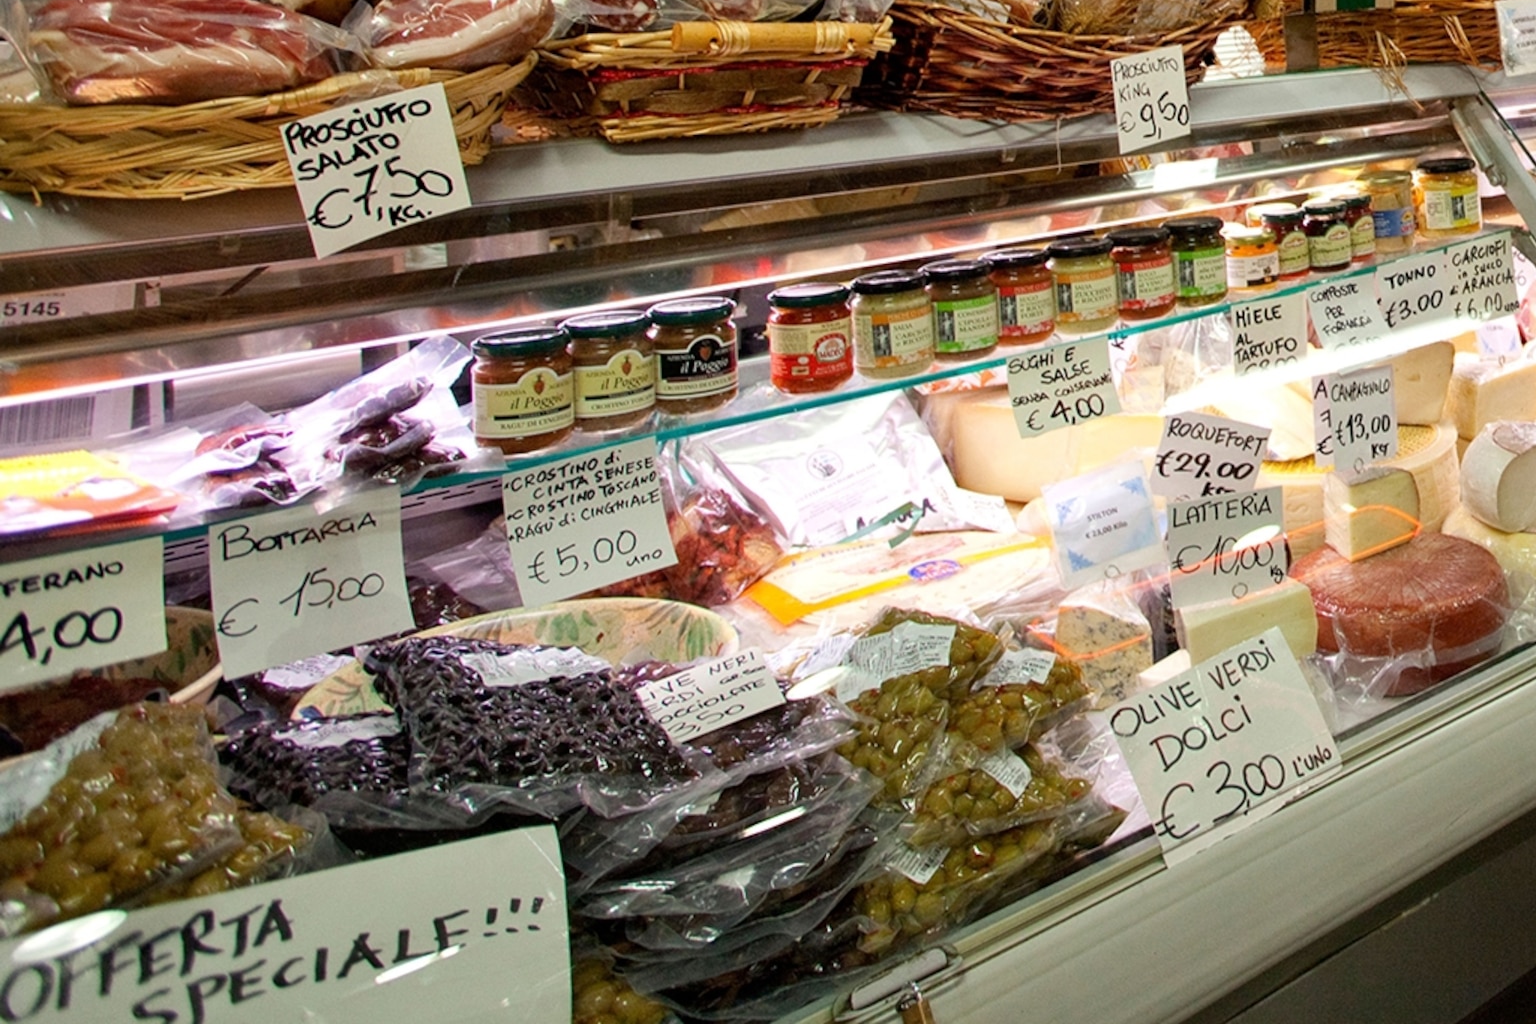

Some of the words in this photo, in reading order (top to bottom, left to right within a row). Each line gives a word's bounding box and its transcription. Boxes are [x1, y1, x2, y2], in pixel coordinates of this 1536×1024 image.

[1113, 57, 1179, 82] PROSCIUTTO
[1118, 82, 1151, 103] KING
[285, 100, 432, 155] PROSCIUTTO
[1120, 111, 1136, 133] €
[1140, 91, 1190, 139] 9,50
[297, 133, 400, 181] SALATO
[308, 188, 352, 228] €
[1384, 264, 1436, 291] TONNO
[1462, 272, 1514, 296] ARANCIA
[3, 301, 60, 317] 5145
[1235, 304, 1282, 327] MIELE
[1234, 337, 1297, 364] TARTUFO
[1235, 332, 1252, 347] AL
[680, 361, 690, 374] il
[691, 358, 729, 373] Poggio
[1008, 349, 1054, 375] SUGHI
[1064, 346, 1076, 362] E
[1041, 360, 1093, 385] SALSE
[600, 378, 611, 391] il
[614, 374, 649, 390] Poggio
[510, 398, 520, 411] il
[523, 392, 565, 410] Poggio
[1026, 409, 1044, 431] €
[1051, 393, 1105, 425] 4,00
[1167, 417, 1269, 458] ROQUEFORT
[604, 450, 622, 466] di
[533, 476, 589, 500] CINTA
[595, 456, 654, 483] SENESE
[600, 470, 658, 498] TOSCANO
[558, 512, 576, 527] di
[581, 488, 661, 521] CINGHIALE
[1086, 506, 1118, 523] STILTON
[1172, 492, 1273, 527] LATTERIA
[218, 512, 377, 562] BOTTARGA
[527, 551, 550, 585] €
[556, 530, 637, 577] 5,00
[626, 548, 663, 567] uno
[217, 598, 259, 638] €
[279, 566, 385, 617] 15,00
[708, 651, 756, 676] NERI
[1110, 681, 1202, 738] OLIVE
[1207, 638, 1277, 691] VERDI
[1149, 694, 1252, 773] DOLCI
[1155, 782, 1201, 840] €
[1292, 745, 1333, 778] L'UNO
[1, 899, 295, 1023] OFFERTA
